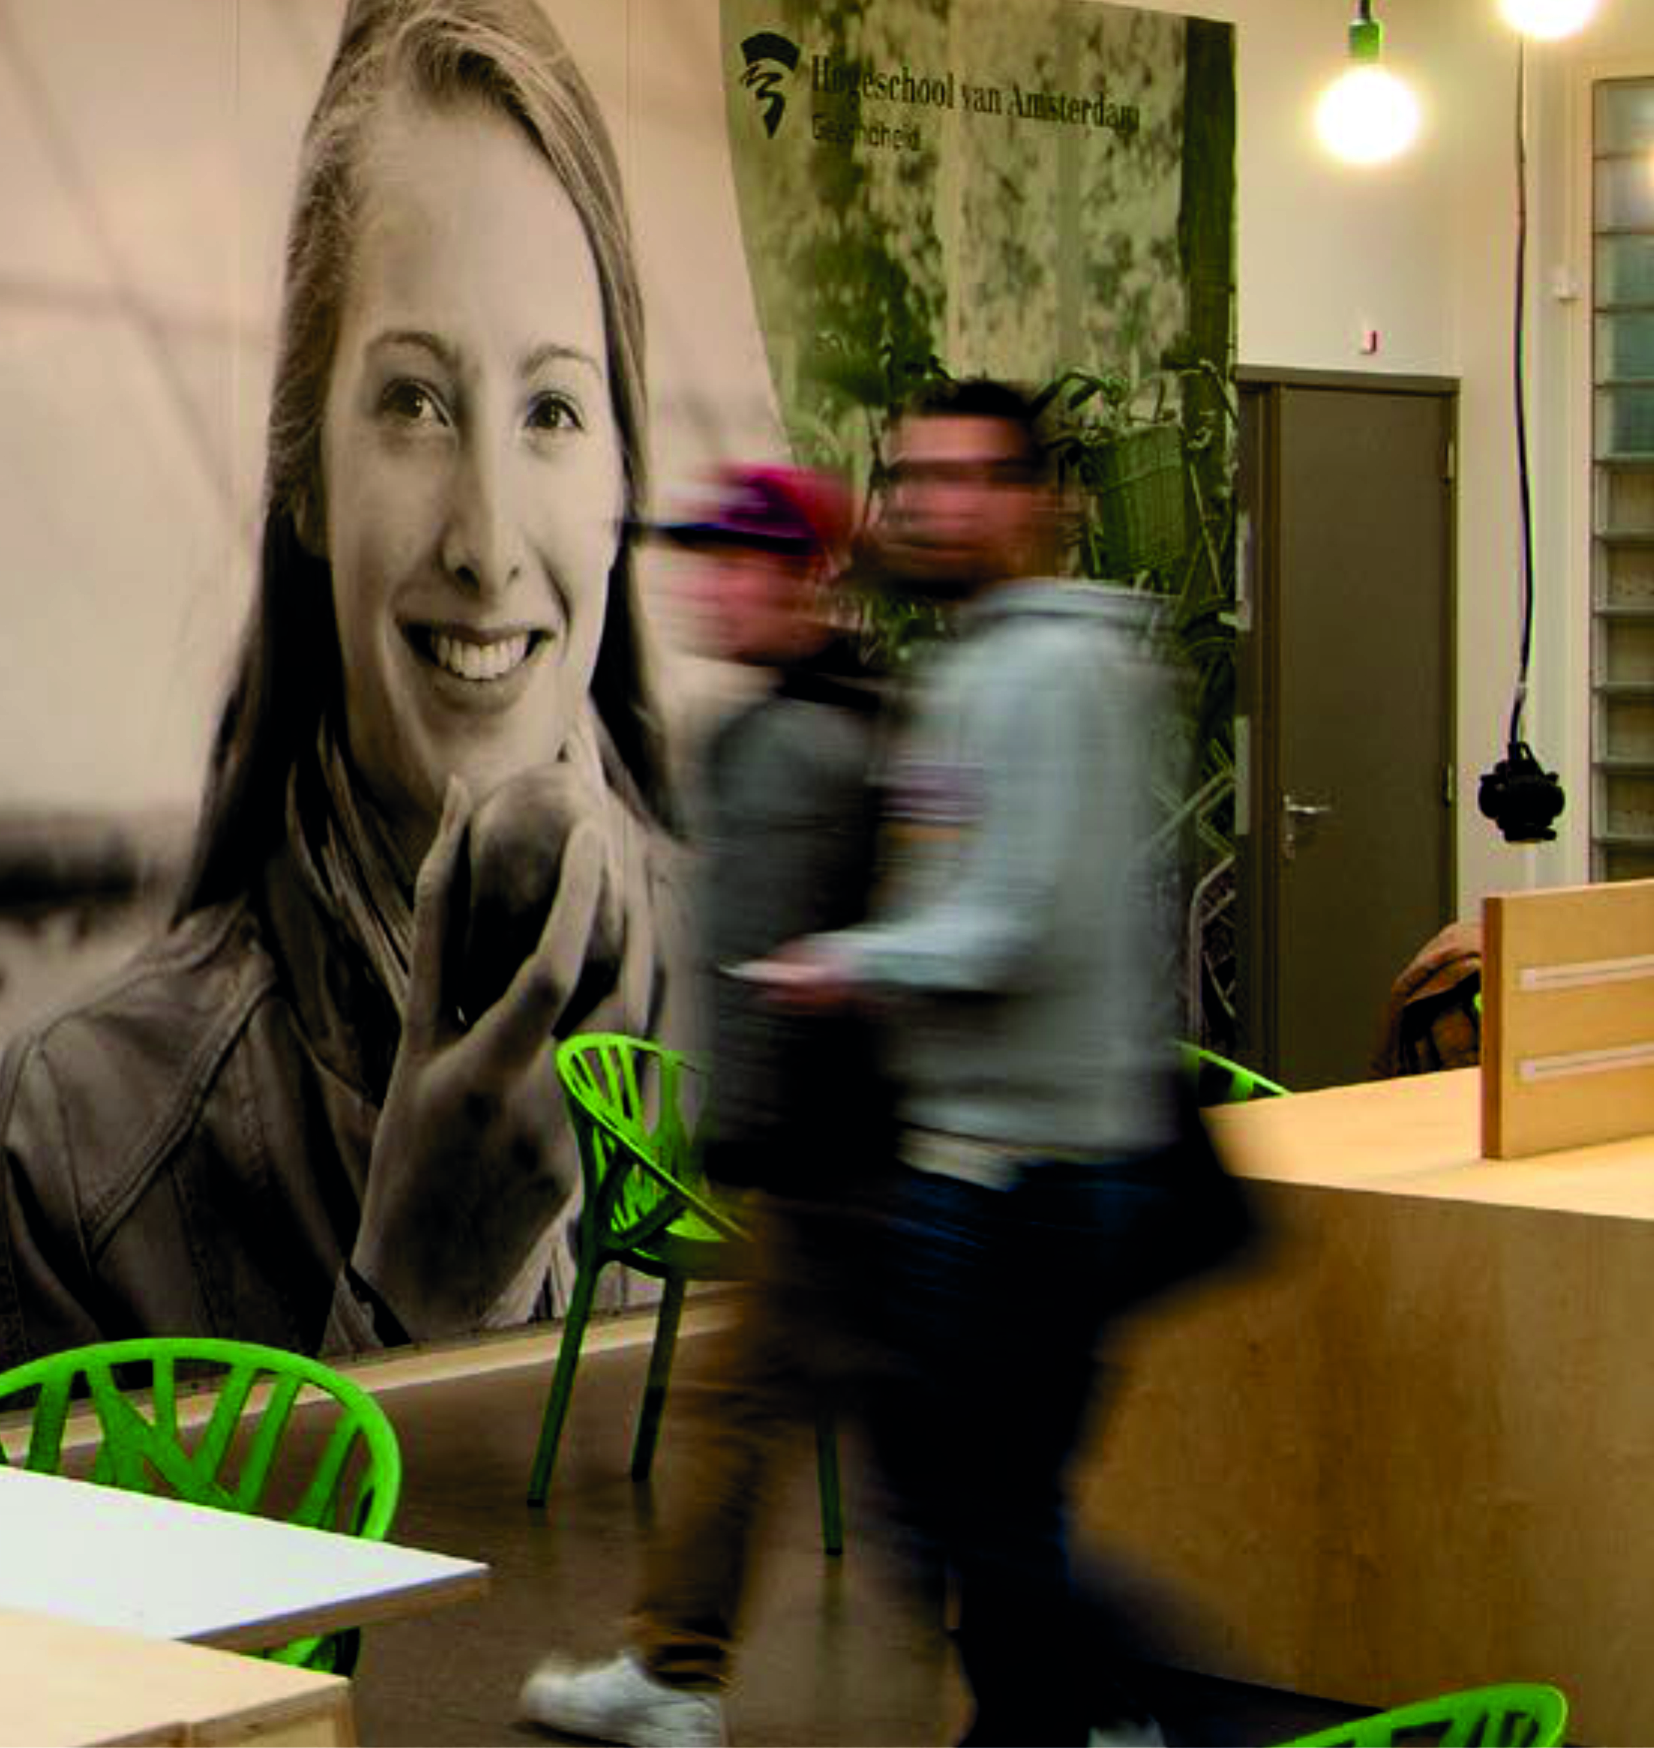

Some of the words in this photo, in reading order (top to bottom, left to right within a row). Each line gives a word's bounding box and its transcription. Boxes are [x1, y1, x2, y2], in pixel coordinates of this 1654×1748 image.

[811, 55, 954, 109] Hogeschool
[961, 84, 1001, 115] van
[1006, 82, 1140, 131] Amsterdam
